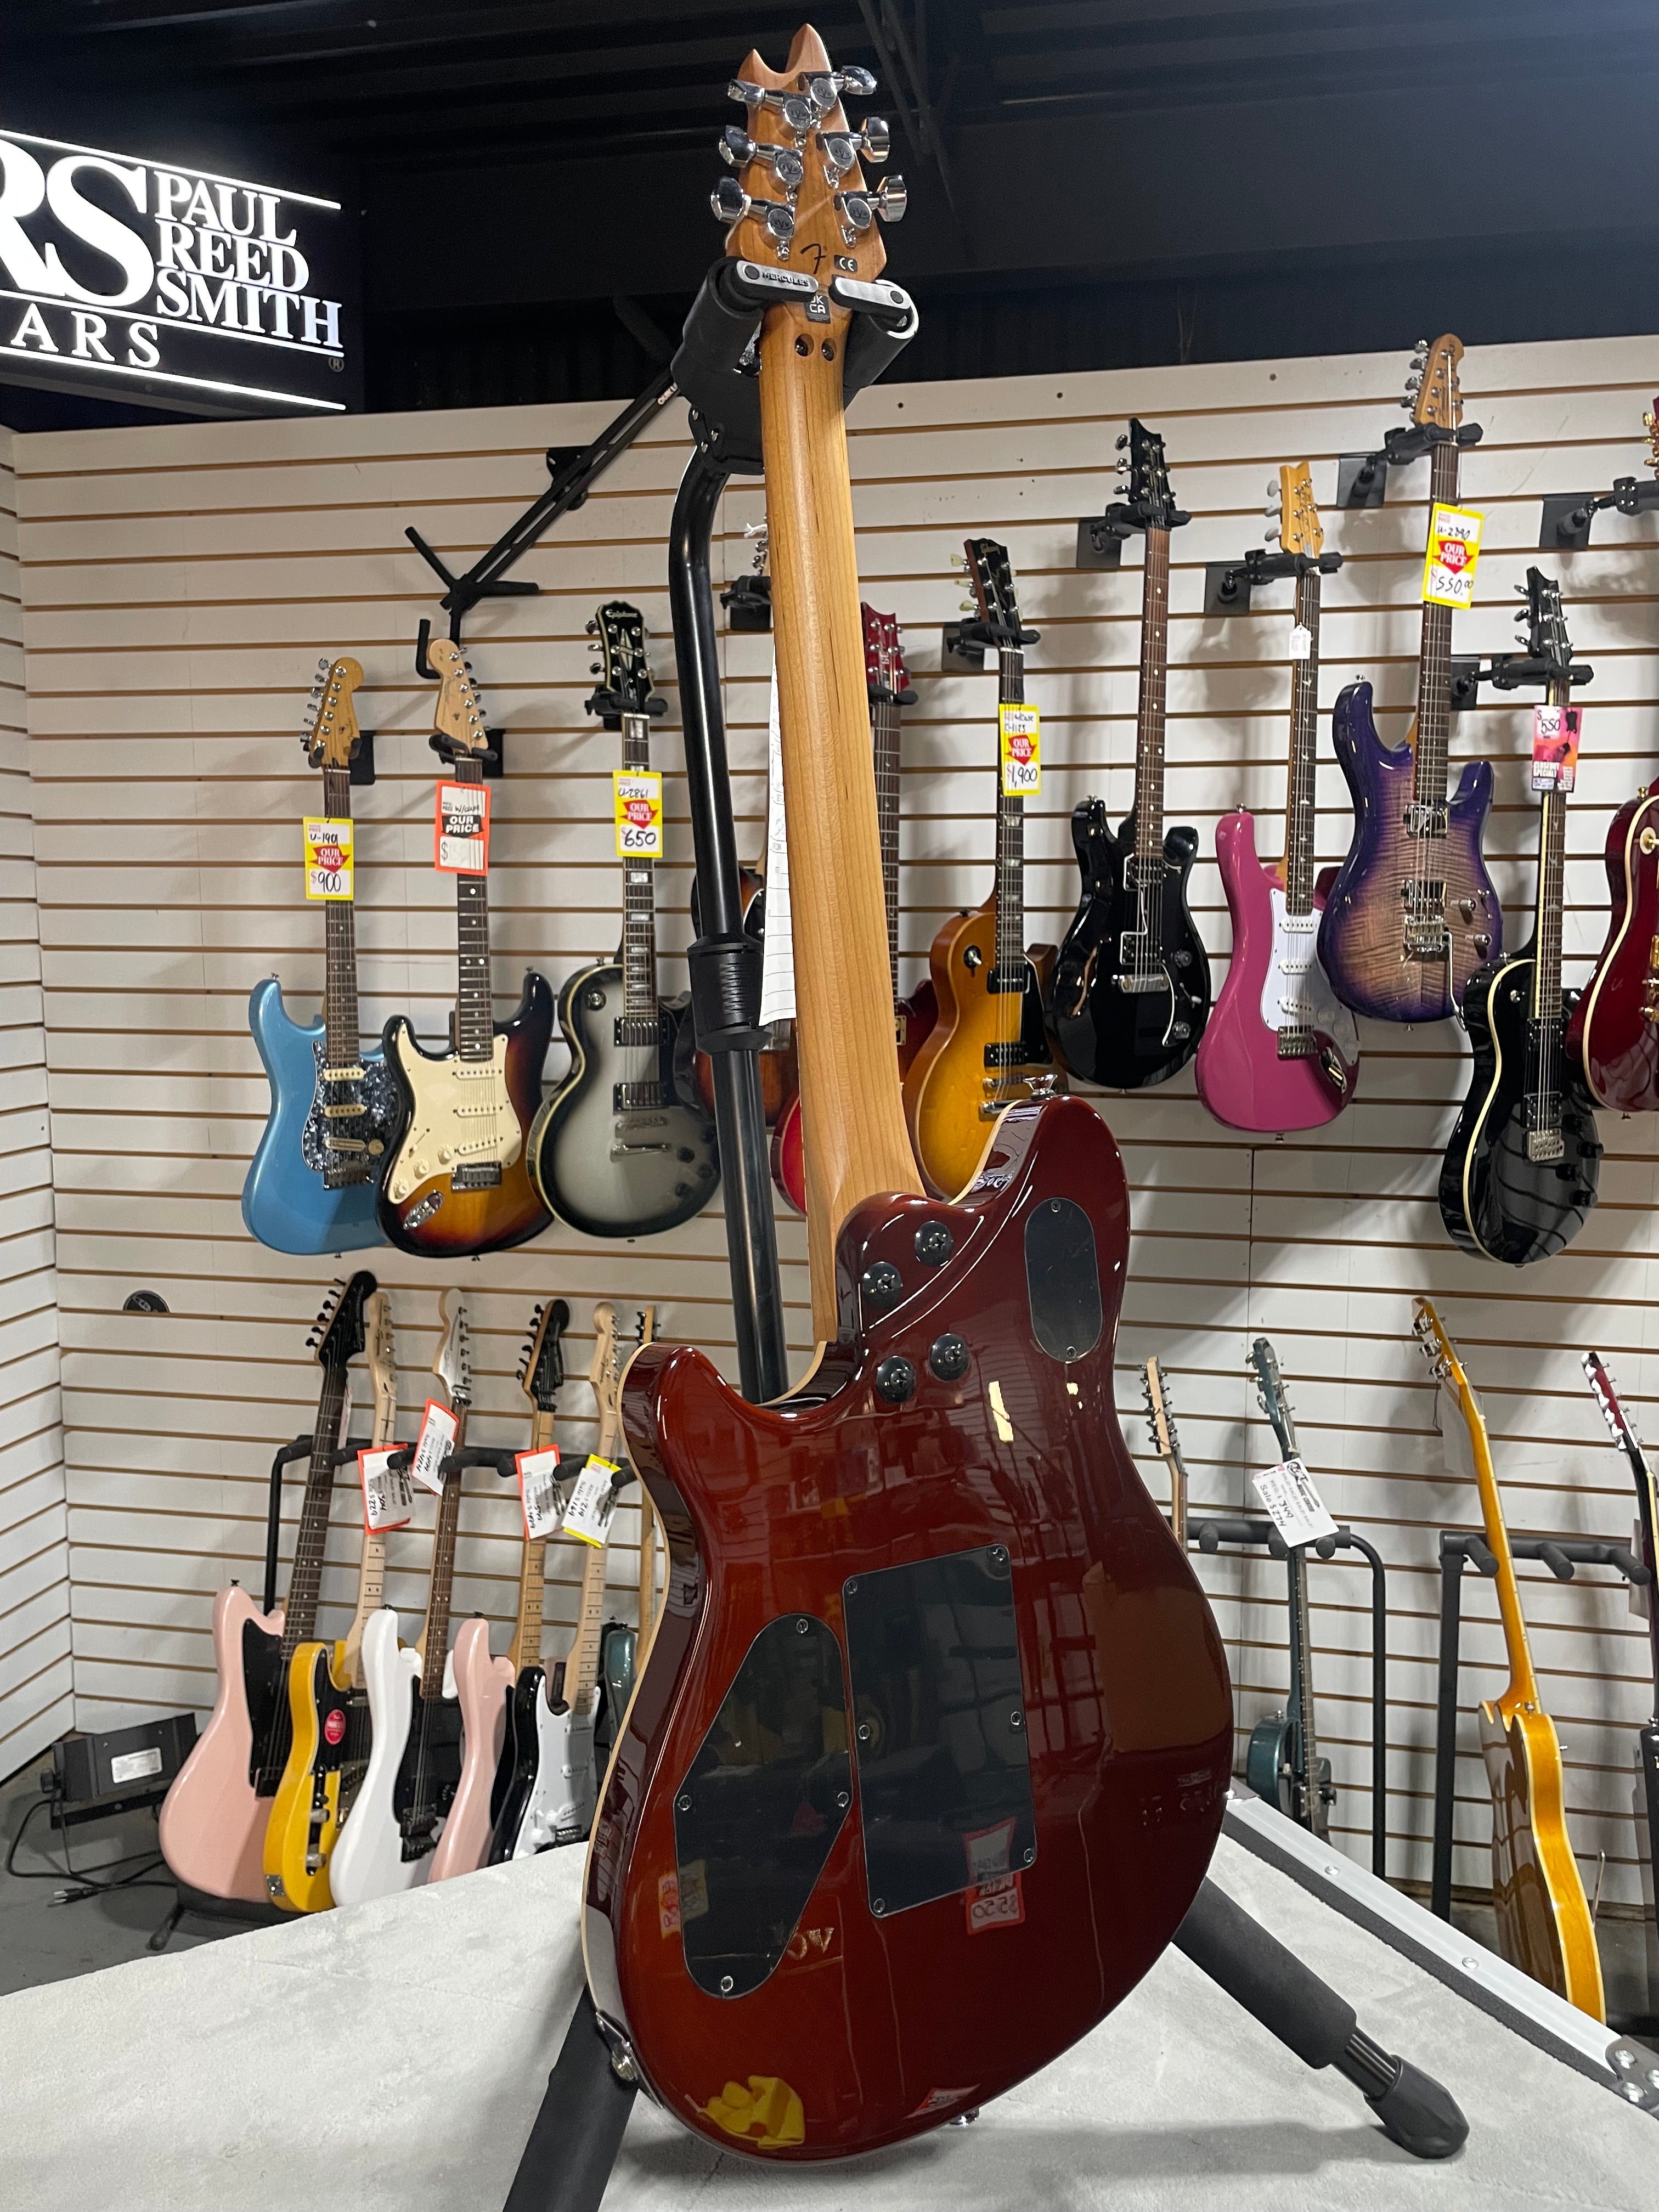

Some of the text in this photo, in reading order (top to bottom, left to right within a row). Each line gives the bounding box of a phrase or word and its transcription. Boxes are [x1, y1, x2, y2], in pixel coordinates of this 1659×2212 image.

[154, 170, 297, 246] PAUL
[155, 218, 309, 292] REED
[839, 257, 854, 272] CE
[762, 272, 809, 287] HERCULES
[156, 268, 343, 348] SMITH
[809, 304, 826, 314] CA
[10, 303, 160, 368] ARS
[1444, 542, 1465, 556] OUR
[1440, 552, 1468, 567] PRICE
[1012, 738, 1030, 748] OUR
[1011, 748, 1032, 758] PRICE
[630, 803, 649, 812] OUR
[449, 815, 474, 825] OUR
[628, 812, 653, 821] PRICE
[445, 823, 480, 833] PRICE
[320, 848, 340, 857] OUR
[318, 856, 343, 866] PRICE
[1260, 1485, 1272, 1503] Sale
